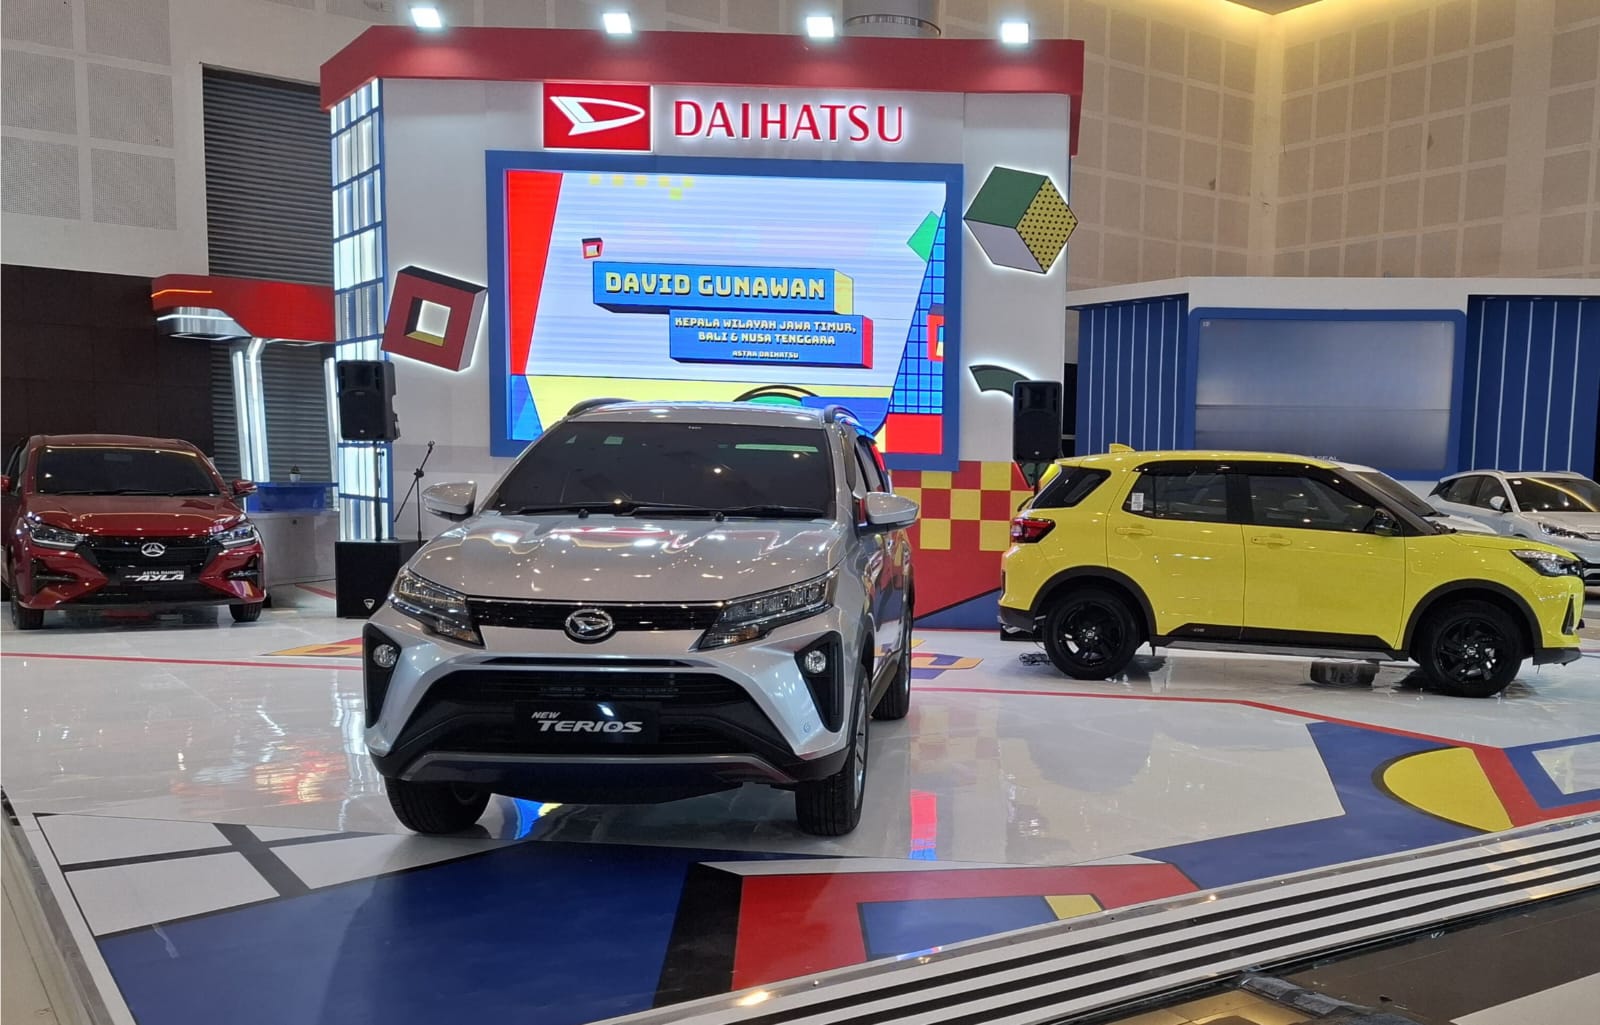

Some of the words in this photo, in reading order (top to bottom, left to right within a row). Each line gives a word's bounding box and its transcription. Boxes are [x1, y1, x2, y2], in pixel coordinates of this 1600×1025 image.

[674, 100, 904, 143] DAIHATSU
[605, 271, 691, 294] DAVID
[698, 275, 826, 299] GUNAWAN
[675, 317, 720, 328] KEPALA
[723, 319, 777, 330] WILAYAH
[779, 321, 811, 332] JAWA
[814, 322, 857, 334] TIMUR,
[698, 331, 729, 342] BALI
[731, 333, 738, 342] &
[741, 333, 773, 344] NUSA
[774, 334, 836, 345] TENGGARA
[732, 350, 758, 358] ASTRA
[759, 351, 800, 359] DAIHATSU
[531, 711, 561, 719] NEW
[537, 720, 643, 733] TERIOS
